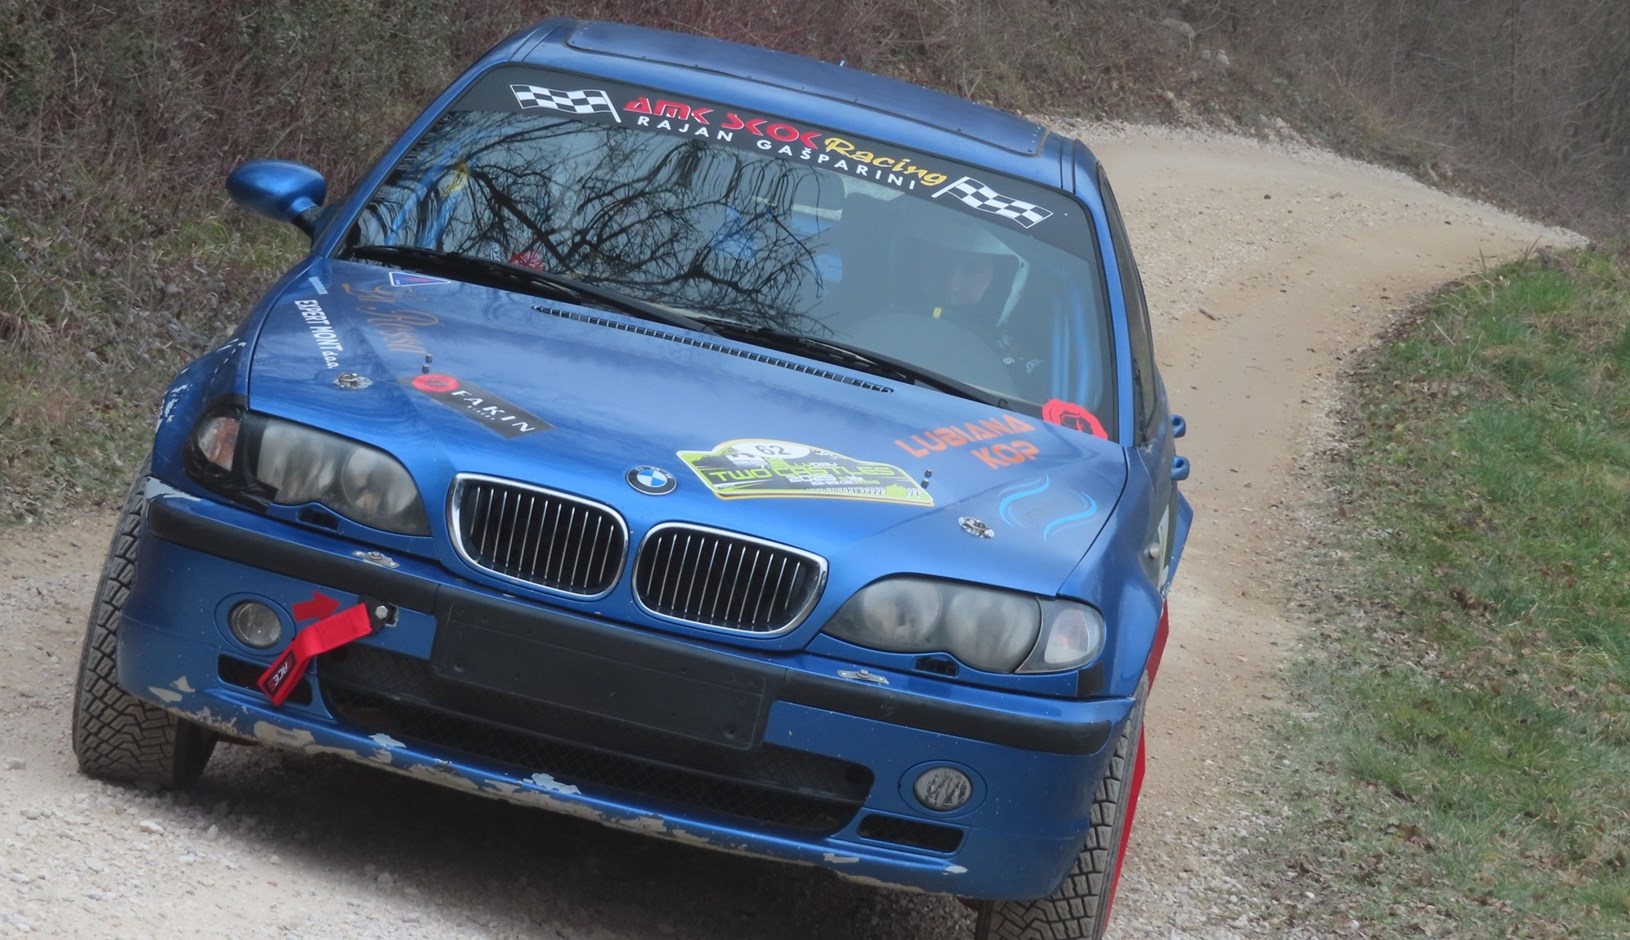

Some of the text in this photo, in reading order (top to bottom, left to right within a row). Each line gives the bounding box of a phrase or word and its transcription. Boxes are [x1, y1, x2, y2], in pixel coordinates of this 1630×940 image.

[637, 115, 915, 190] RAJAN GAŠPARINI
[824, 137, 947, 187] Racing
[294, 299, 330, 325] EXPERT
[309, 326, 344, 351] MONT
[451, 390, 535, 432] FAKIN
[755, 445, 792, 456] 62
[894, 414, 1036, 458] LUBIANA
[970, 440, 1040, 470] KOP
[709, 468, 773, 482] TWO
[772, 464, 896, 477] CASTLES
